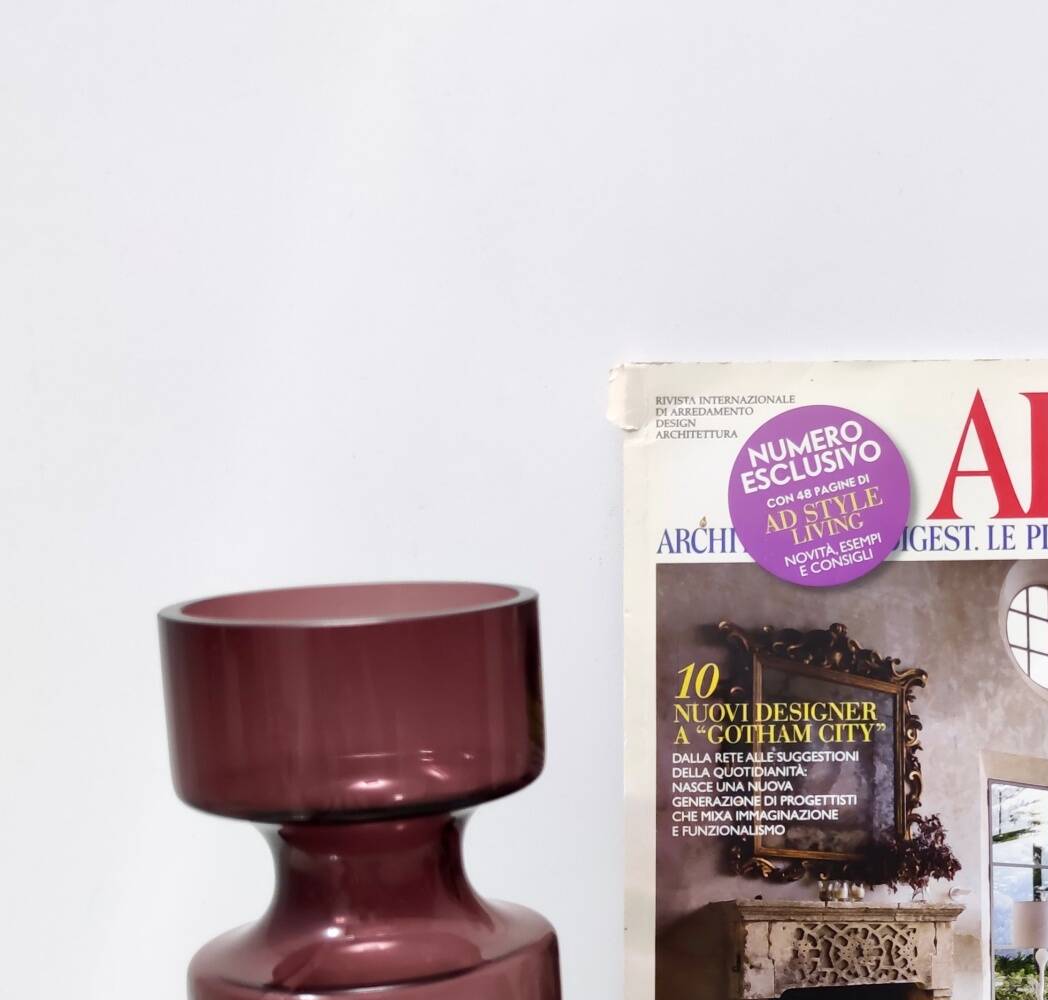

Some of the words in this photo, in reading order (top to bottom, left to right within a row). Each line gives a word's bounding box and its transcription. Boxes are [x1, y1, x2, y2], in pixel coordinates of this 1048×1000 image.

[656, 396, 696, 405] RIVISTA
[700, 395, 796, 405] INTERNAZIONALE
[656, 408, 667, 417] DI
[671, 407, 754, 416] ARREDAMENTO
[656, 419, 696, 428] DESIGN
[656, 430, 738, 439] ARCHITETTURA
[748, 421, 862, 467] NUMERO
[741, 440, 881, 494] ESCLUSIVO
[767, 493, 794, 508] CON
[797, 488, 812, 500] 48
[816, 478, 857, 496] PAGINE
[859, 474, 870, 485] DI
[766, 509, 798, 534] AD
[803, 486, 883, 524] STYLE
[792, 513, 864, 545] LIVING
[988, 526, 1015, 550] LE
[784, 544, 839, 567] NOVITÀ,
[841, 533, 881, 553] ESEMPI
[800, 565, 808, 577] E
[811, 549, 873, 574] CONSIGLI
[674, 662, 720, 699] 10
[673, 704, 748, 723] NUOVI
[756, 702, 877, 722] DESIGNER
[674, 726, 690, 745] A
[672, 752, 712, 764] DALLA
[716, 752, 743, 763] RETE
[745, 752, 775, 763] ALLE
[777, 751, 859, 762] SUGGESTIONI
[672, 767, 710, 778] DELLA
[672, 782, 713, 793] NASCE
[717, 782, 743, 793] UNA
[748, 781, 793, 792] NUOVA
[672, 796, 760, 808] GENERAZIONE
[764, 796, 777, 807] DI
[782, 795, 857, 806] PROGETTISTI
[672, 811, 698, 822] CHE
[702, 811, 733, 822] MIXA
[736, 810, 839, 821] IMMAGINAZIONE
[672, 826, 679, 837] E
[683, 824, 785, 837] FUNZIONALISMO
